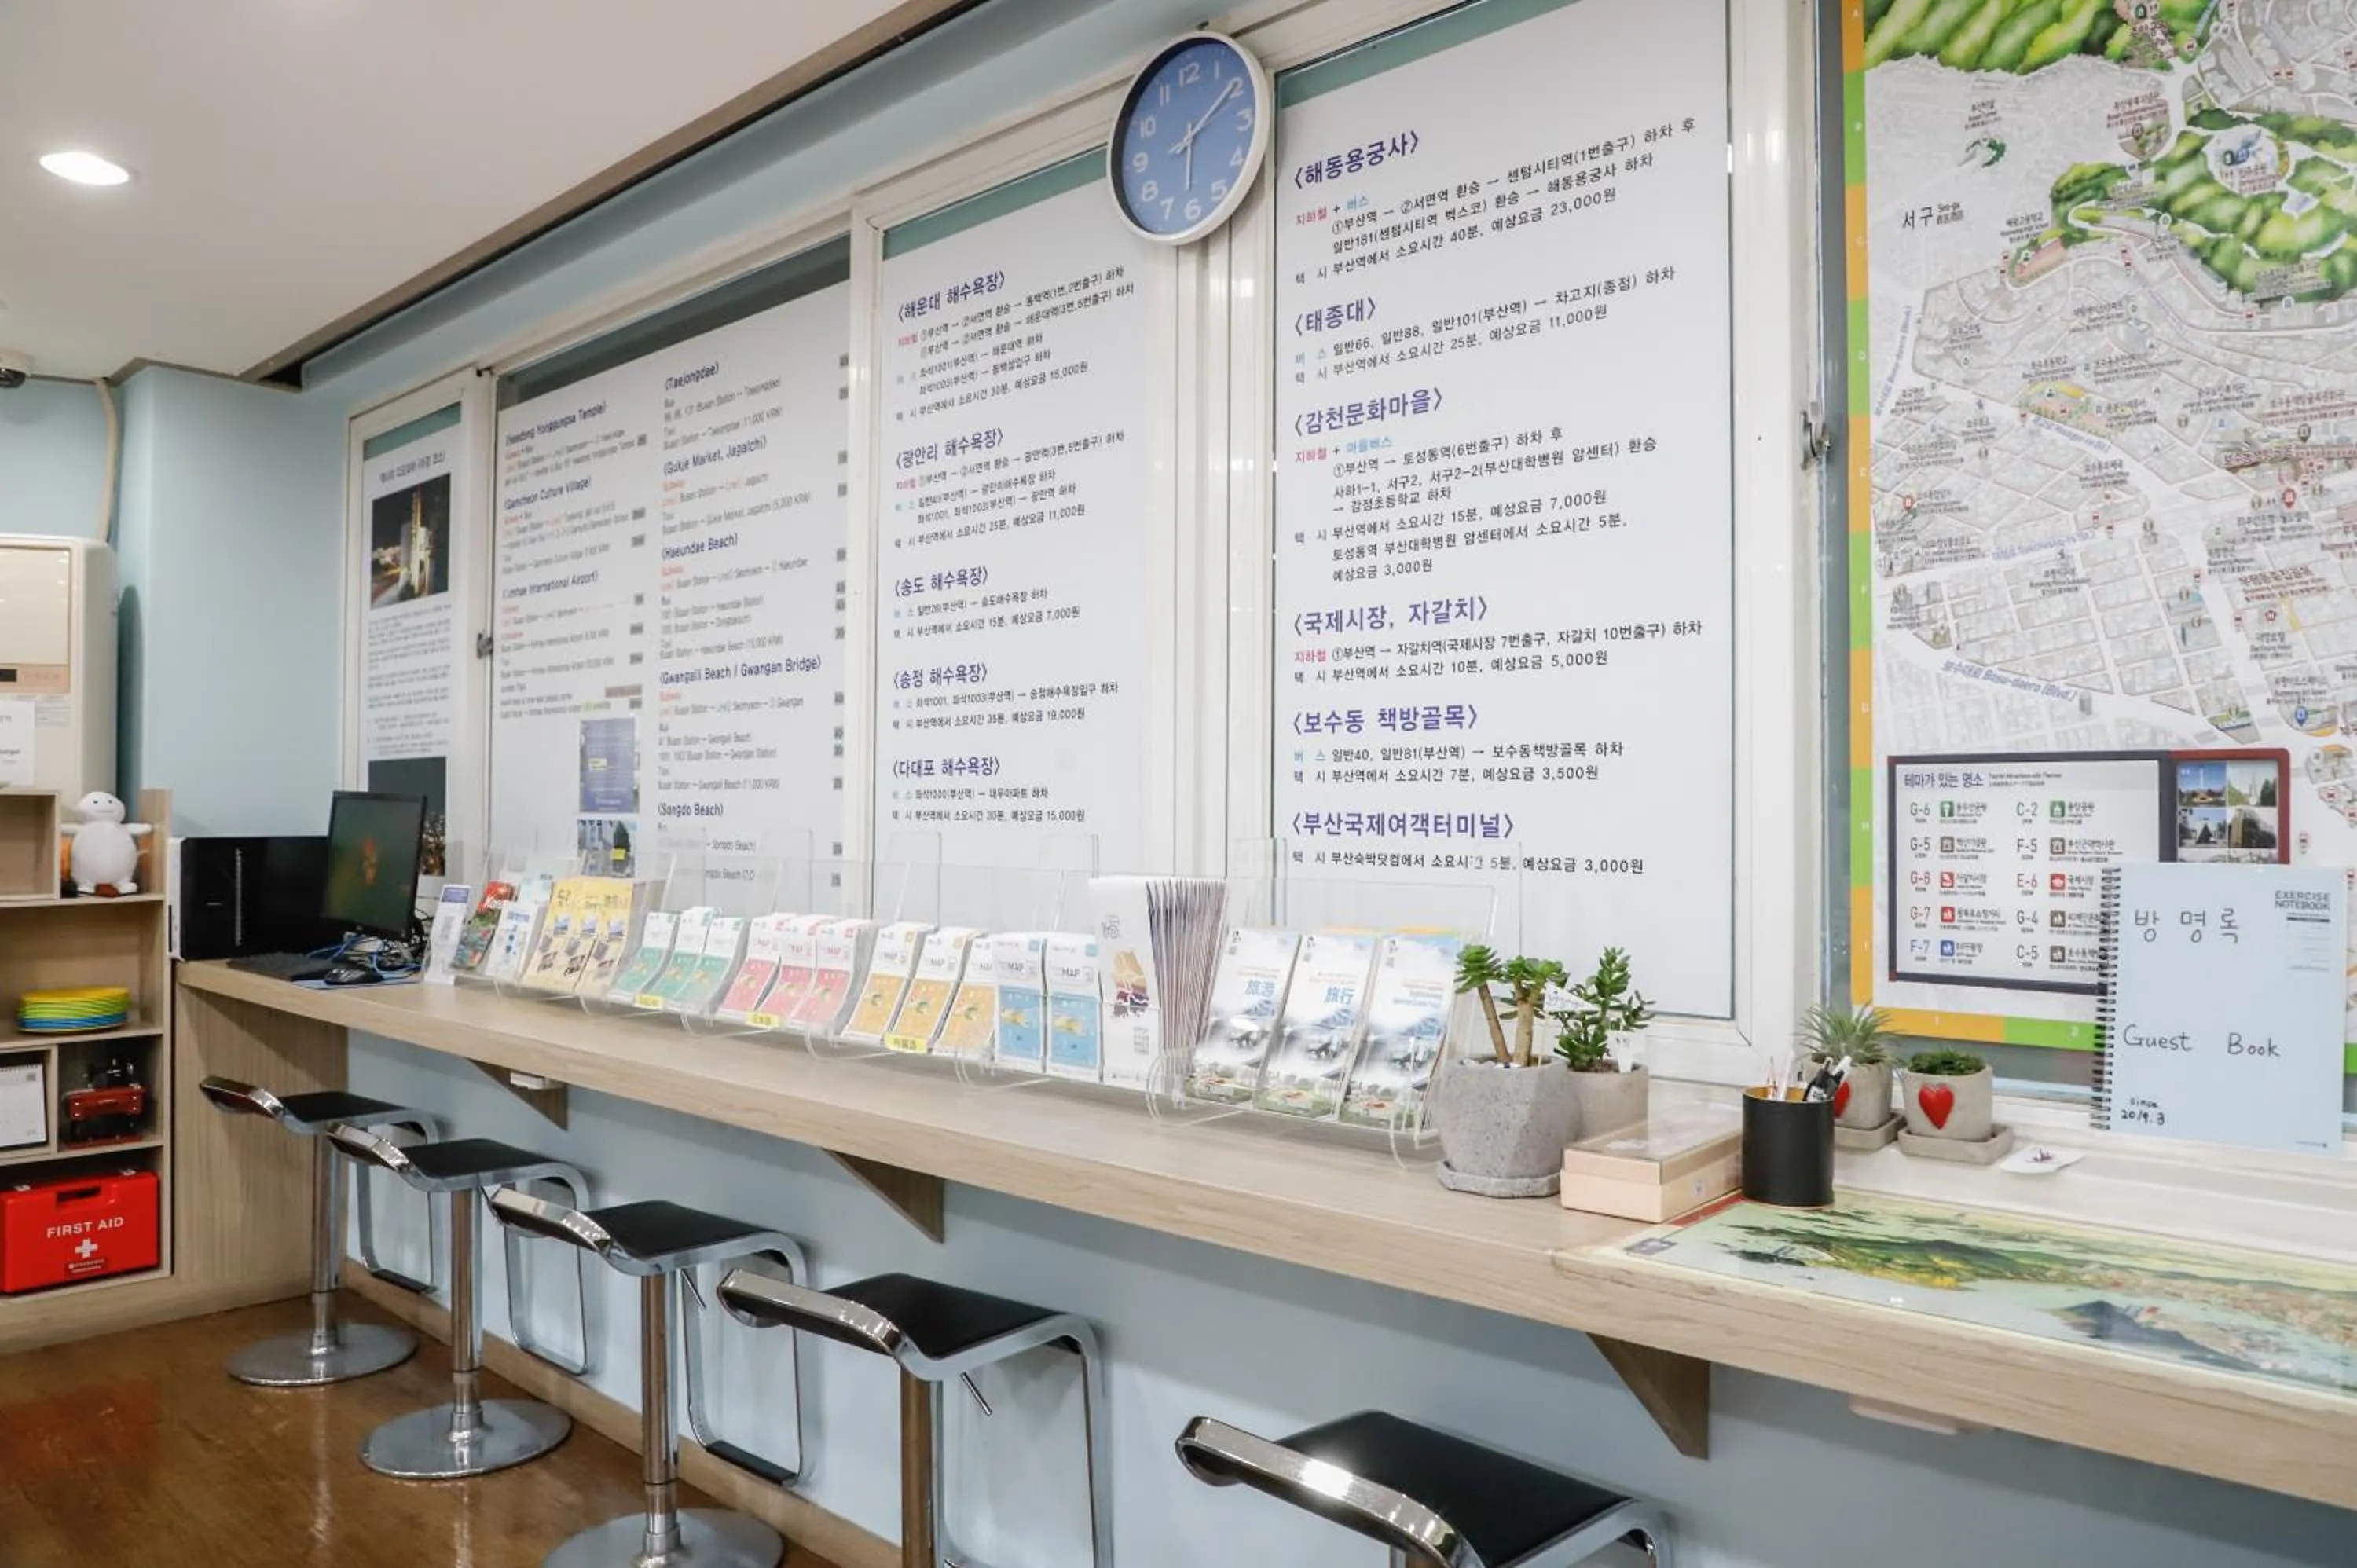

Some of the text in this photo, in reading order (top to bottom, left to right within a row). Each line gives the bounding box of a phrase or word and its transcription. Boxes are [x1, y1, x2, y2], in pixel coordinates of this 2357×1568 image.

[1179, 63, 1200, 86] 12
[1160, 85, 1170, 106] 11
[1229, 77, 1244, 99] 2
[1140, 117, 1156, 138] 10
[1237, 108, 1252, 131] 3
[1133, 152, 1148, 173] 9
[1230, 146, 1244, 167] 4
[1141, 180, 1158, 202] 8
[1211, 180, 1226, 201] 5
[1160, 197, 1175, 221] 7
[1184, 199, 1201, 221] 6
[2016, 802, 2038, 817] C-2
[1910, 837, 1930, 852] G-5
[2275, 890, 2331, 903] EXERCISE
[2123, 1023, 2281, 1057] Guest Book
[46, 1217, 124, 1239] FIRST AID
